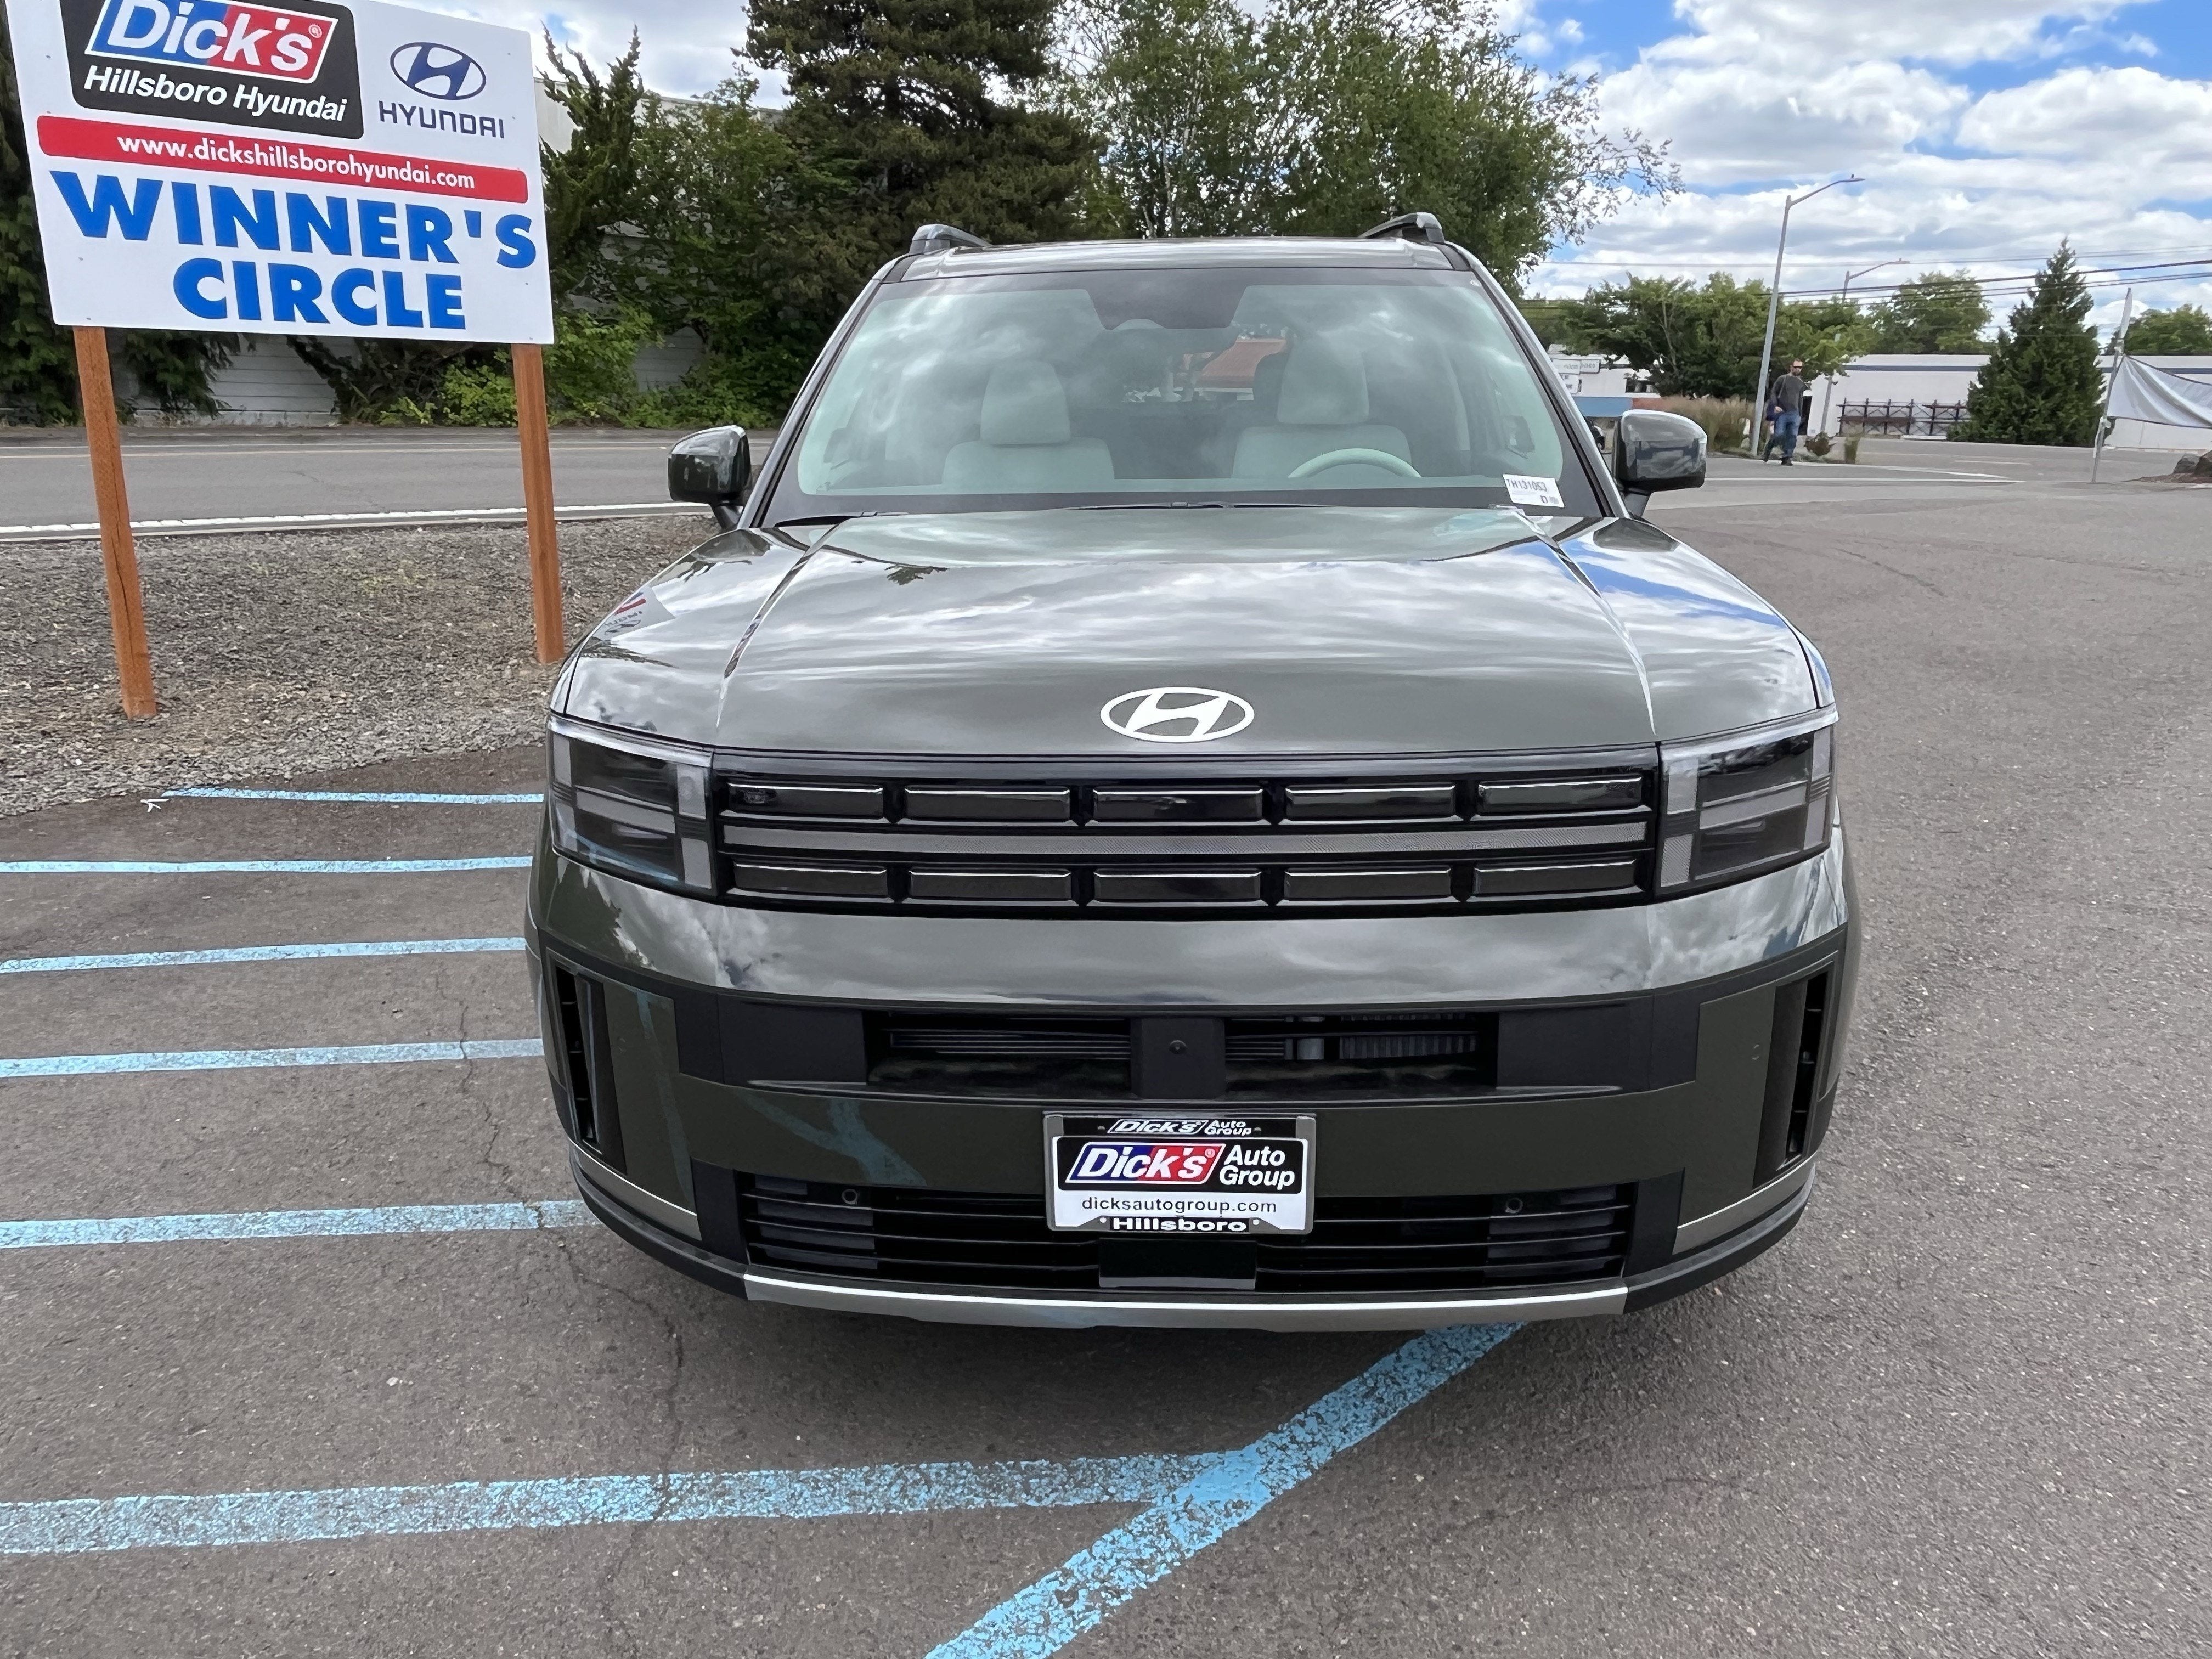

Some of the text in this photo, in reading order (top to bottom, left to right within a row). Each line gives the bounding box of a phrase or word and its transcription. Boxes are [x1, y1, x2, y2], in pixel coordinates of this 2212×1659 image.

[108, 0, 312, 71] Dick's
[84, 65, 347, 121] Hillsboro Hyundai
[379, 101, 504, 138] HYUNDAI
[117, 137, 474, 188] www.dickshillsborohyundai.com
[52, 171, 535, 268] WINNER'S
[174, 258, 465, 329] CIRCLE
[1204, 1127, 1251, 1136] Group
[1209, 1120, 1246, 1128] Auto
[1077, 1147, 1207, 1178] Dick's
[1224, 1145, 1285, 1166] Auto
[1220, 1165, 1295, 1190] Group
[1082, 1197, 1277, 1215] dicksautogroup.com
[1113, 1217, 1247, 1232] Hillsboro
